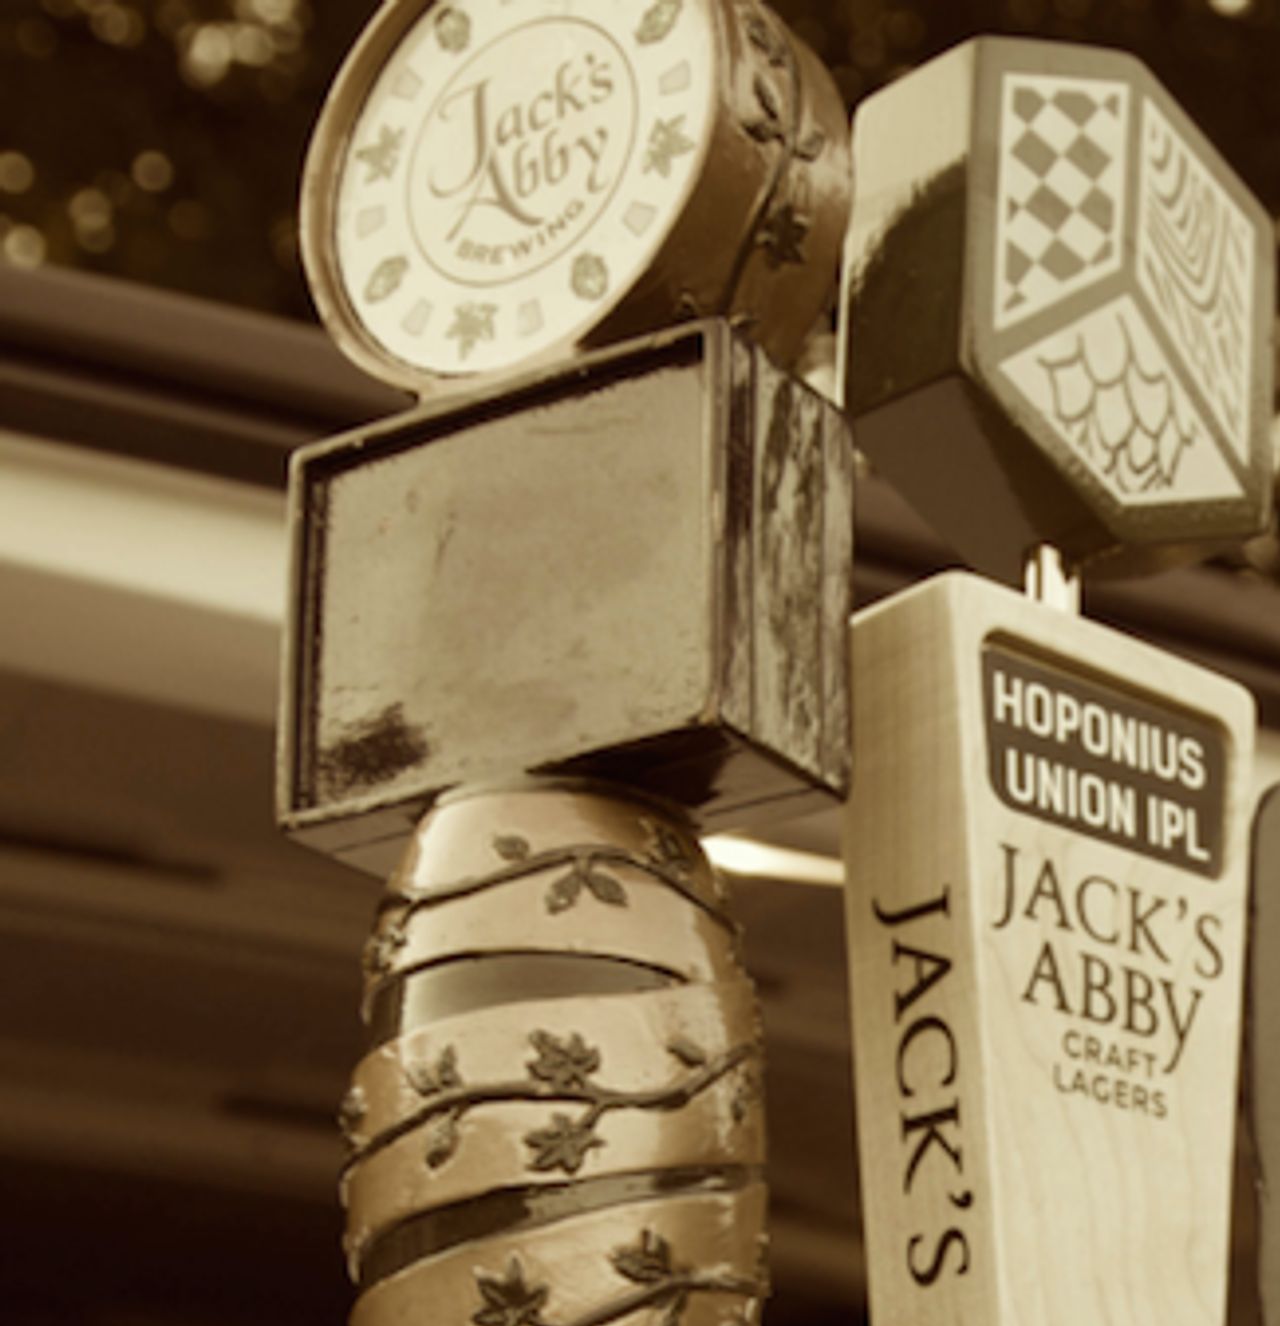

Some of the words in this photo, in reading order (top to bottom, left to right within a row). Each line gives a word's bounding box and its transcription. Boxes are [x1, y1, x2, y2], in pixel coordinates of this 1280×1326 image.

[427, 52, 615, 199] Jack's
[445, 126, 611, 242] Abby
[455, 200, 586, 265] BREWING
[992, 671, 1206, 790] HOPONIUS
[1004, 749, 1137, 836] UNION
[1148, 796, 1212, 862] IPL
[992, 842, 1224, 982] JACK'S
[1020, 939, 1203, 1075] ABBY
[1061, 1028, 1160, 1081] CRAFT
[872, 884, 972, 1289] JACK'S
[1053, 1065, 1170, 1121] LAGERS
